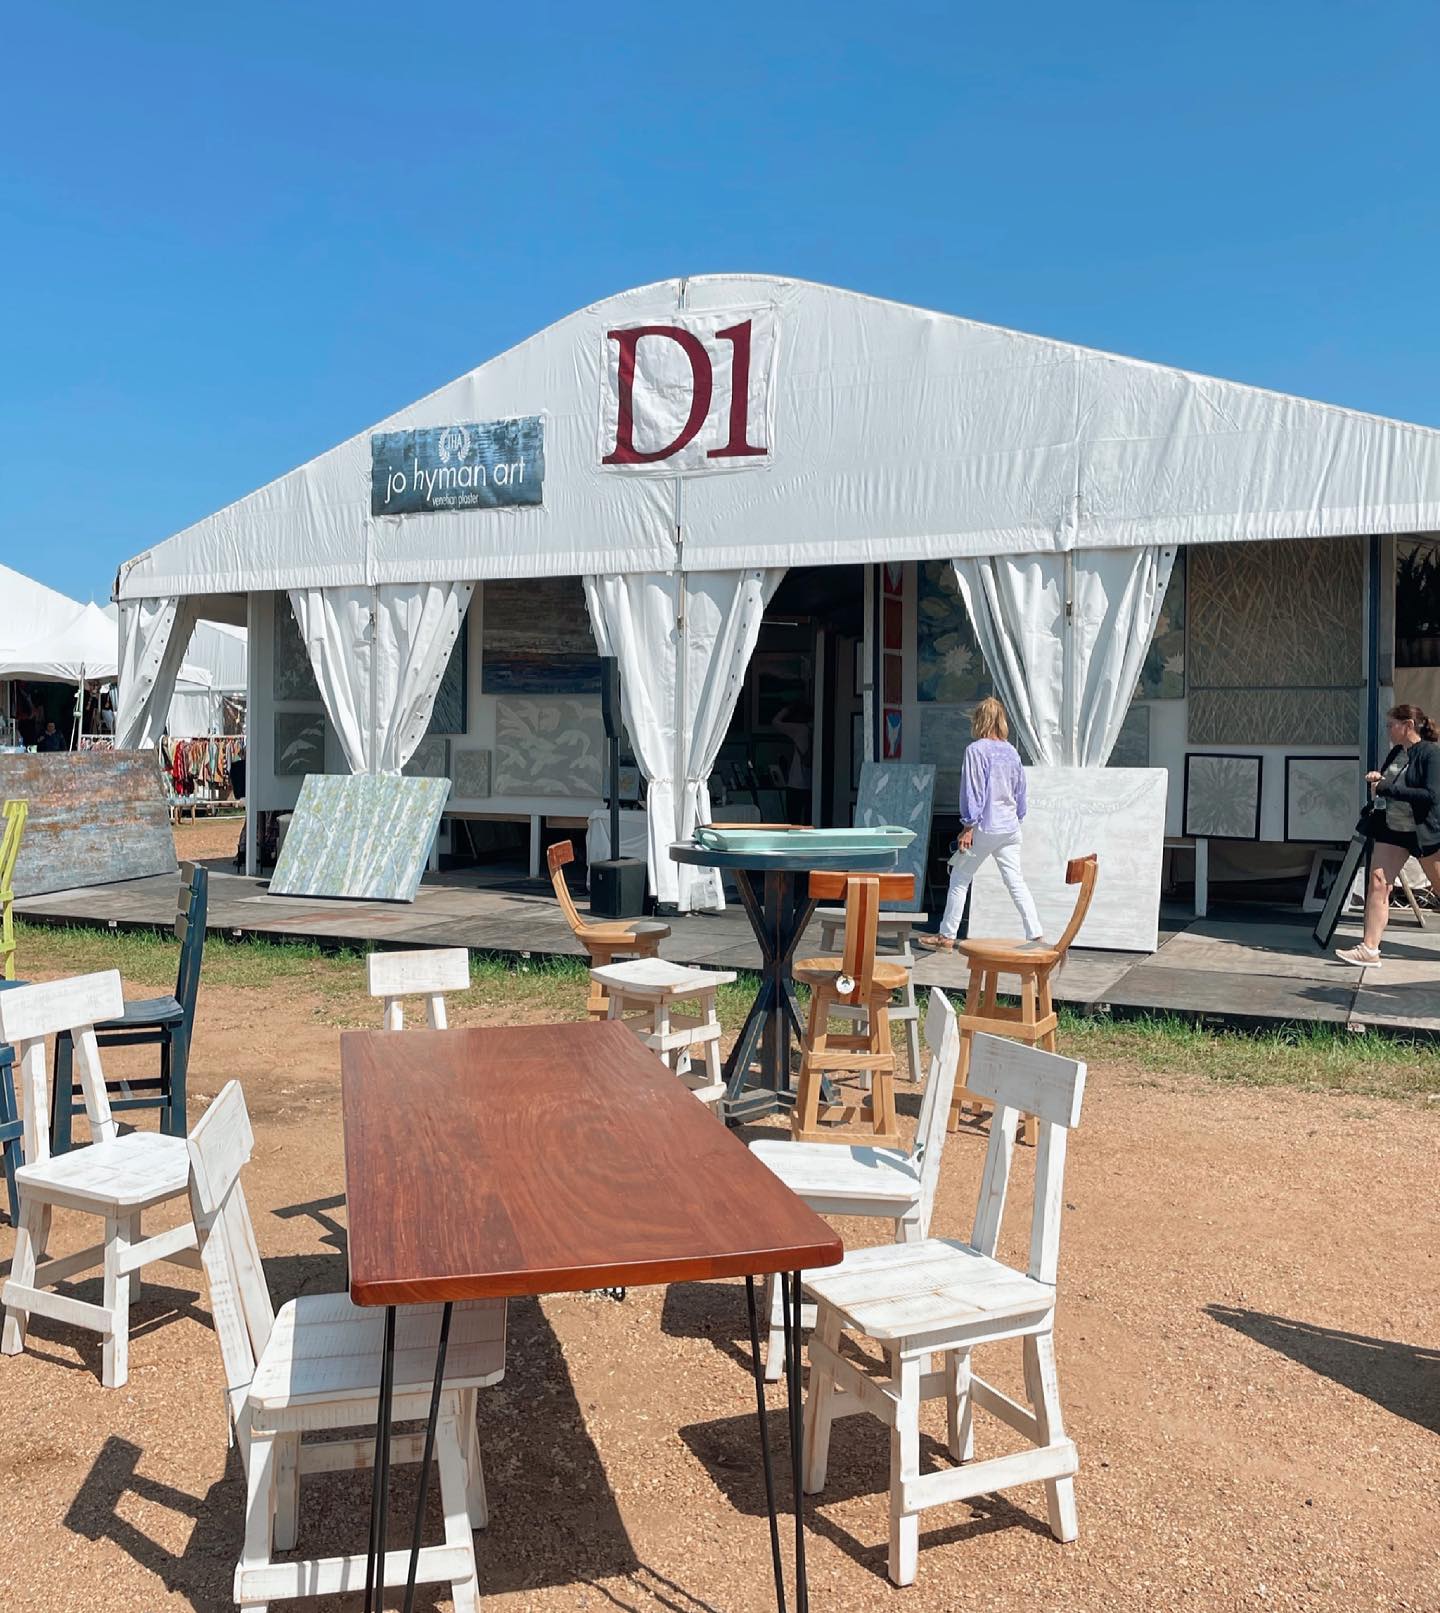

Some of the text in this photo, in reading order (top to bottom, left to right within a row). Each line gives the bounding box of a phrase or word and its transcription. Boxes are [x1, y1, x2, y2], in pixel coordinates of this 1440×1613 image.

[602, 319, 768, 465] D1
[446, 433, 462, 450] JHA
[385, 456, 525, 504] jo hyman art
[432, 491, 479, 508] venetian plaster
